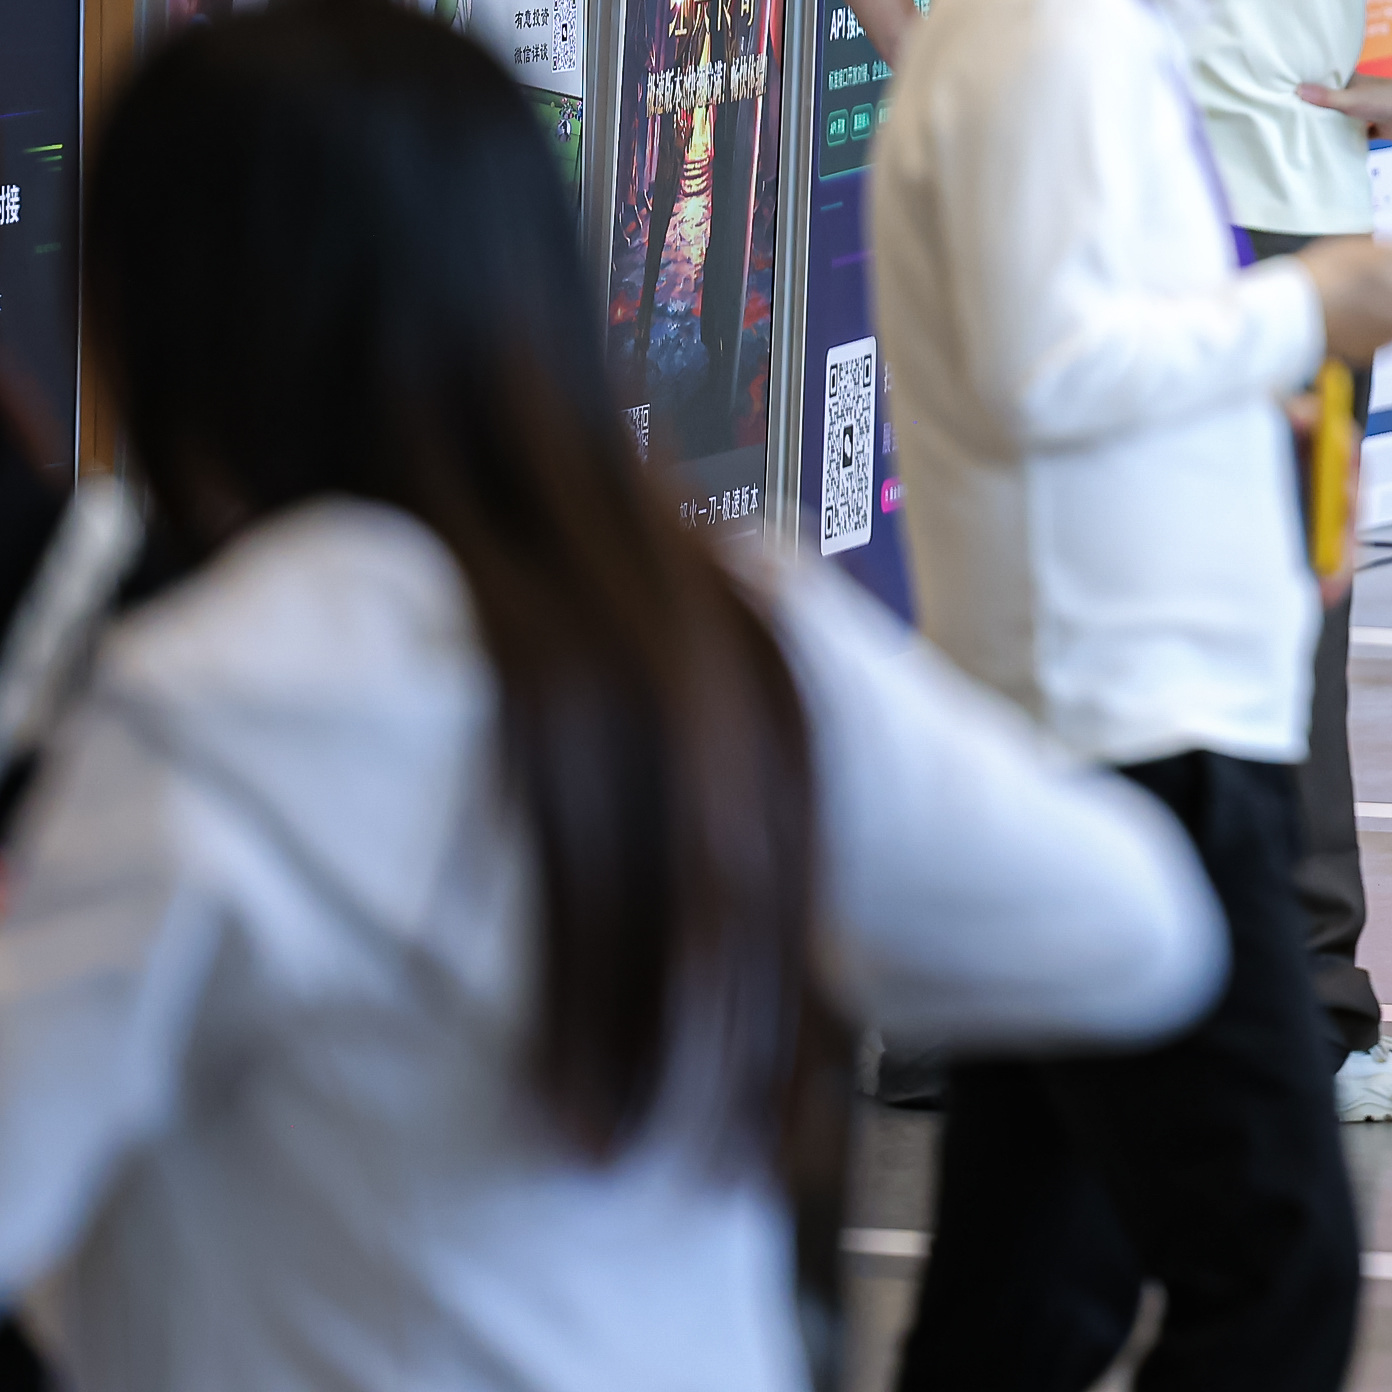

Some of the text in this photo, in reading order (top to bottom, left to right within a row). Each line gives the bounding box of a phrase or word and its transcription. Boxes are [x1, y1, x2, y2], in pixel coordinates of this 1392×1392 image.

[514, 7, 550, 30] 有意投资
[829, 8, 846, 42] API
[514, 43, 549, 65] 微信详谈
